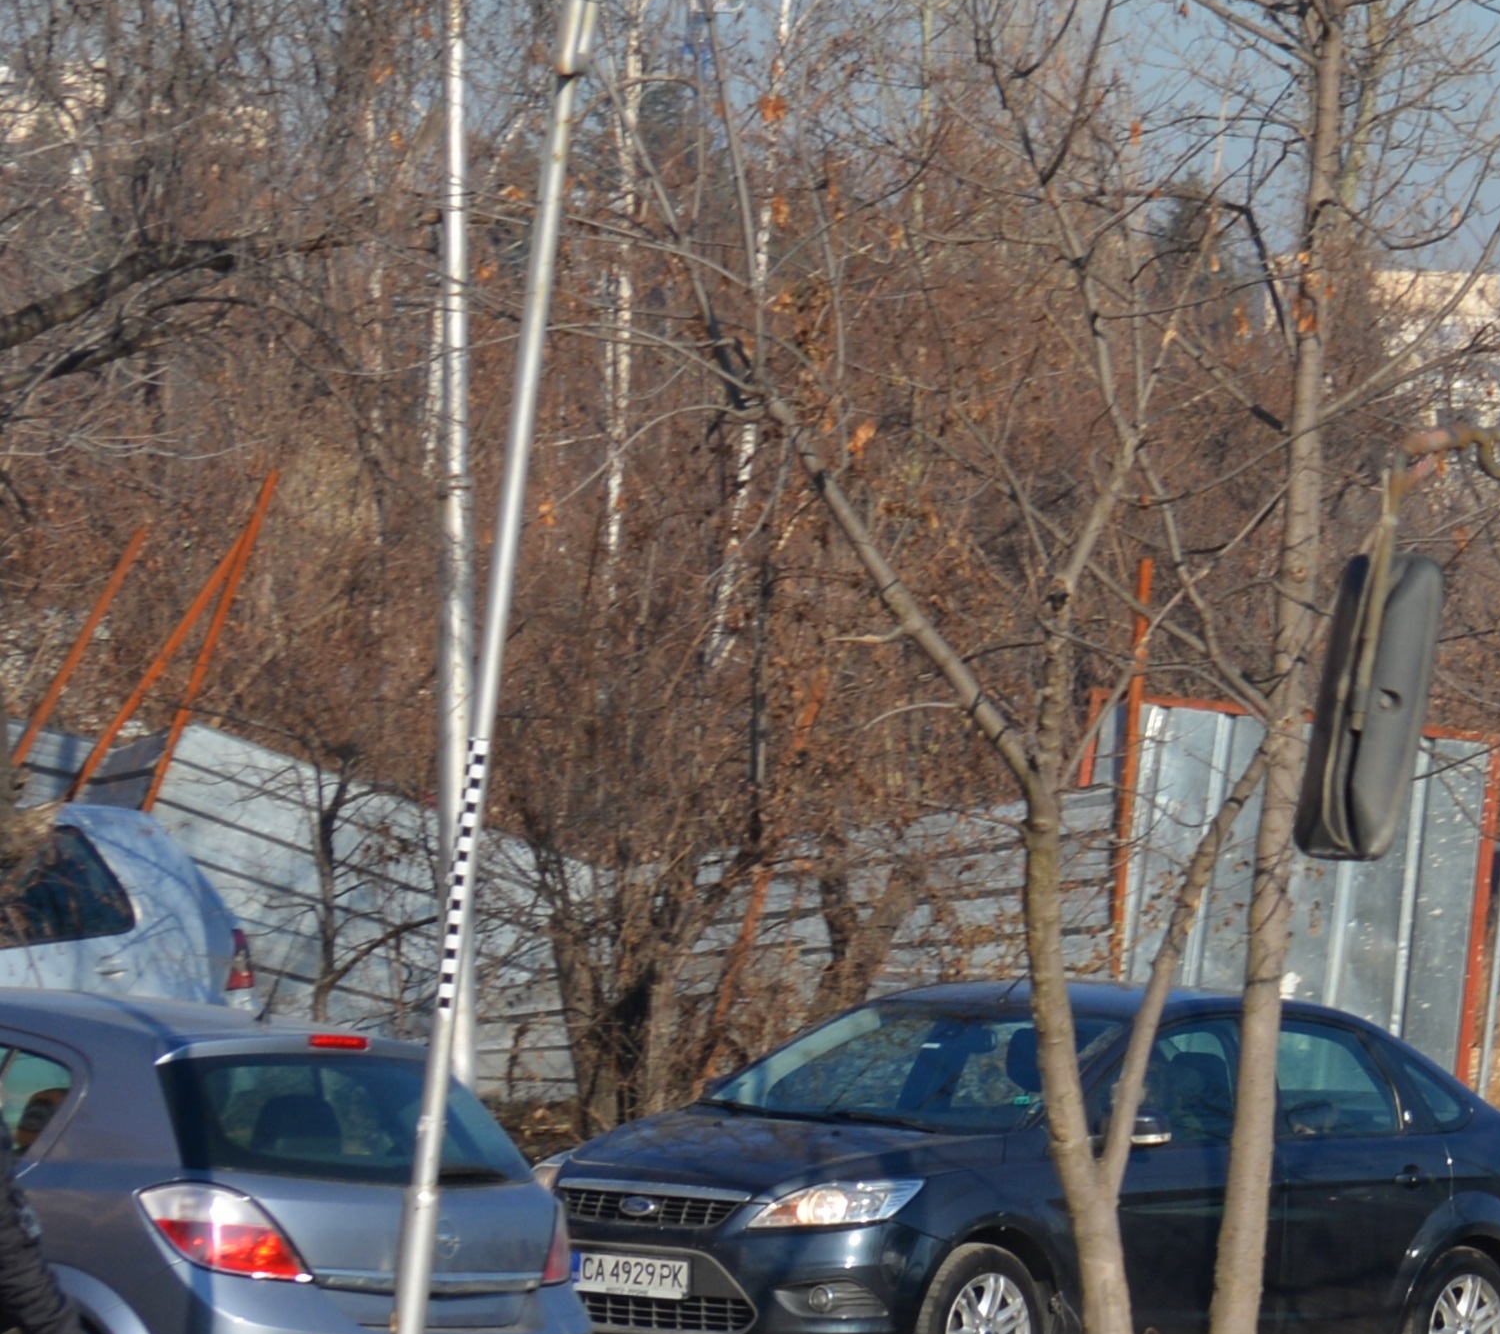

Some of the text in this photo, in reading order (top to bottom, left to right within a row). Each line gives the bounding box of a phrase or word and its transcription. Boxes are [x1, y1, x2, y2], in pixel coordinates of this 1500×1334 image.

[582, 1257, 605, 1282] CA
[610, 1260, 656, 1286] 4929
[659, 1263, 683, 1288] PK
